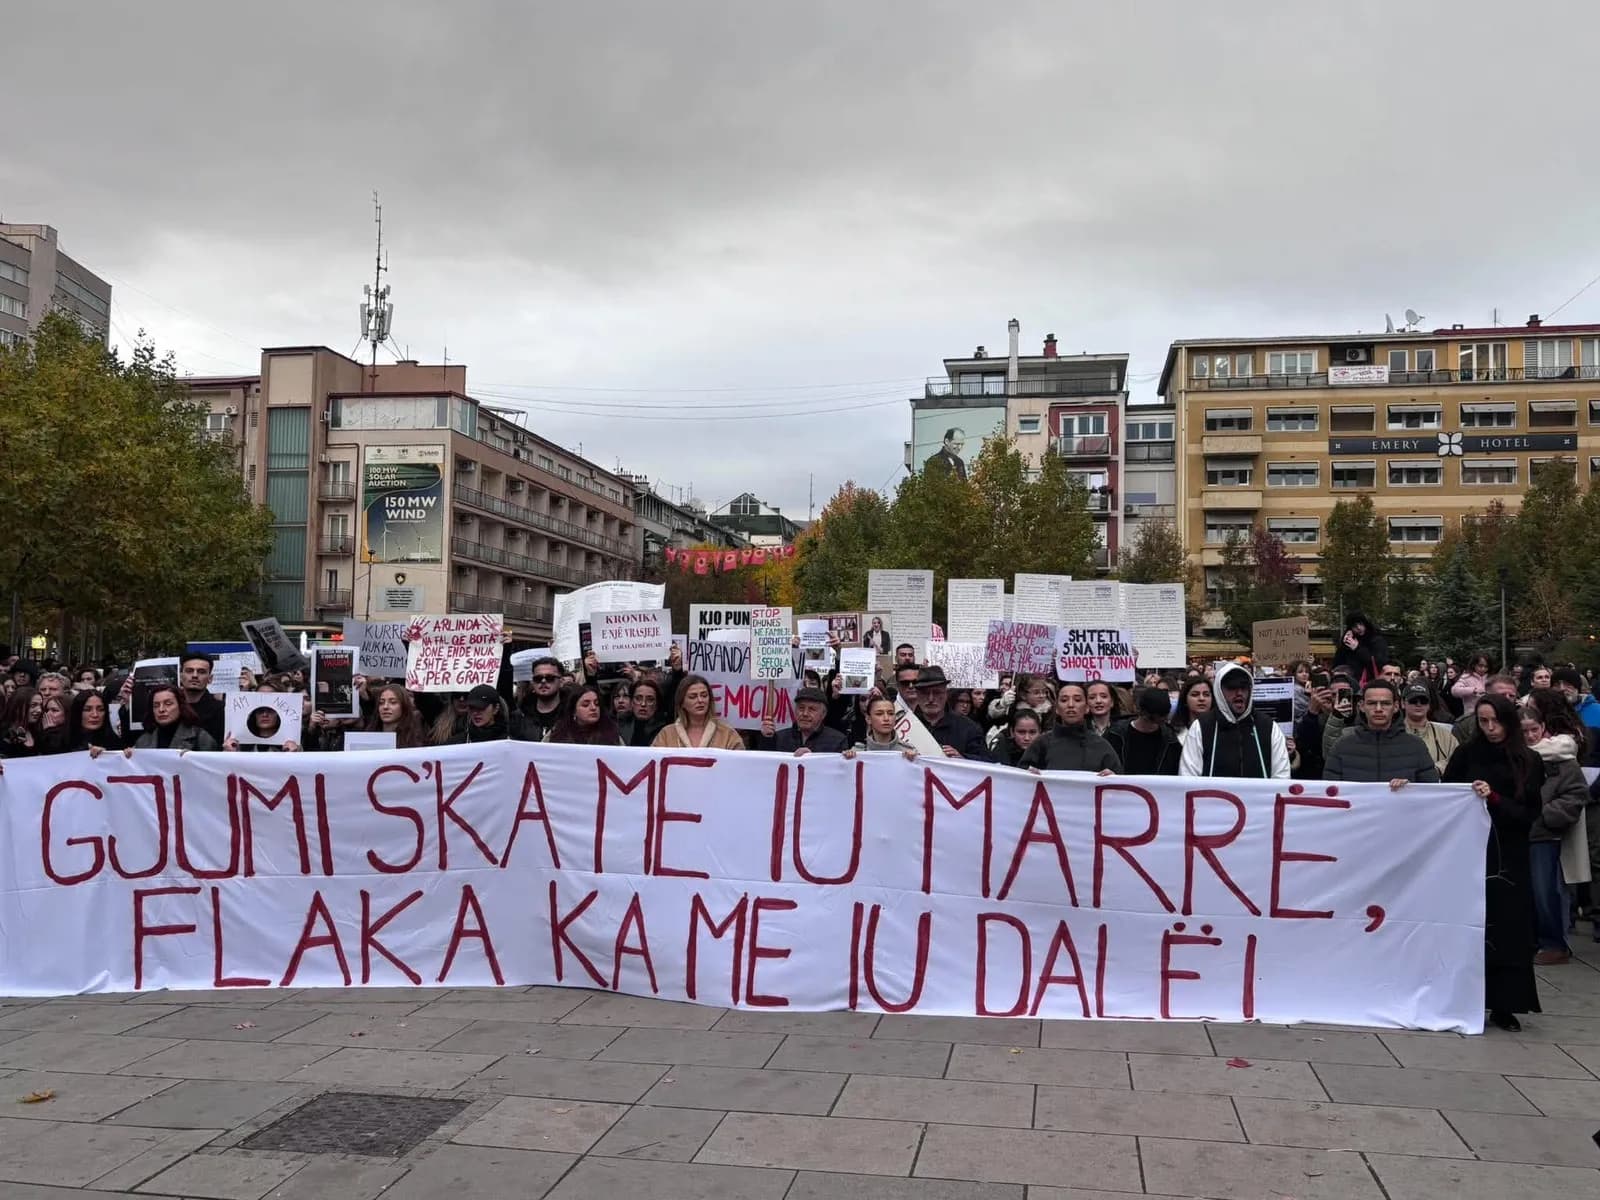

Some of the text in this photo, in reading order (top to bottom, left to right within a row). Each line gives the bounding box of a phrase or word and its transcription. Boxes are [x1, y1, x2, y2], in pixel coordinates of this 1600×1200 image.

[1372, 438, 1530, 449] EMERY HOTEL
[384, 496, 437, 508] 150 MW
[385, 509, 426, 519] WIND
[605, 613, 658, 625] KRONIKA
[699, 610, 722, 626] KJO
[752, 608, 781, 618] STOP
[433, 618, 481, 632] ARLINDA
[601, 629, 608, 639] E
[1068, 628, 1120, 643] SHTETI
[1274, 626, 1289, 637] ALL
[434, 635, 449, 645] FAL
[361, 641, 396, 654] NUK KA
[446, 645, 472, 657] ENDE
[473, 646, 495, 657] NUK
[1062, 642, 1094, 656] S'NA
[452, 658, 460, 670] E
[1060, 655, 1105, 670] SHOQET
[757, 667, 784, 678] STOP
[232, 695, 250, 712] AM
[42, 757, 1387, 933] GJUMI S'KA ME IU MARRË,
[133, 885, 506, 990] FLAKA
[550, 880, 659, 994] KA
[685, 892, 798, 1008] ME
[848, 902, 932, 1013] IU
